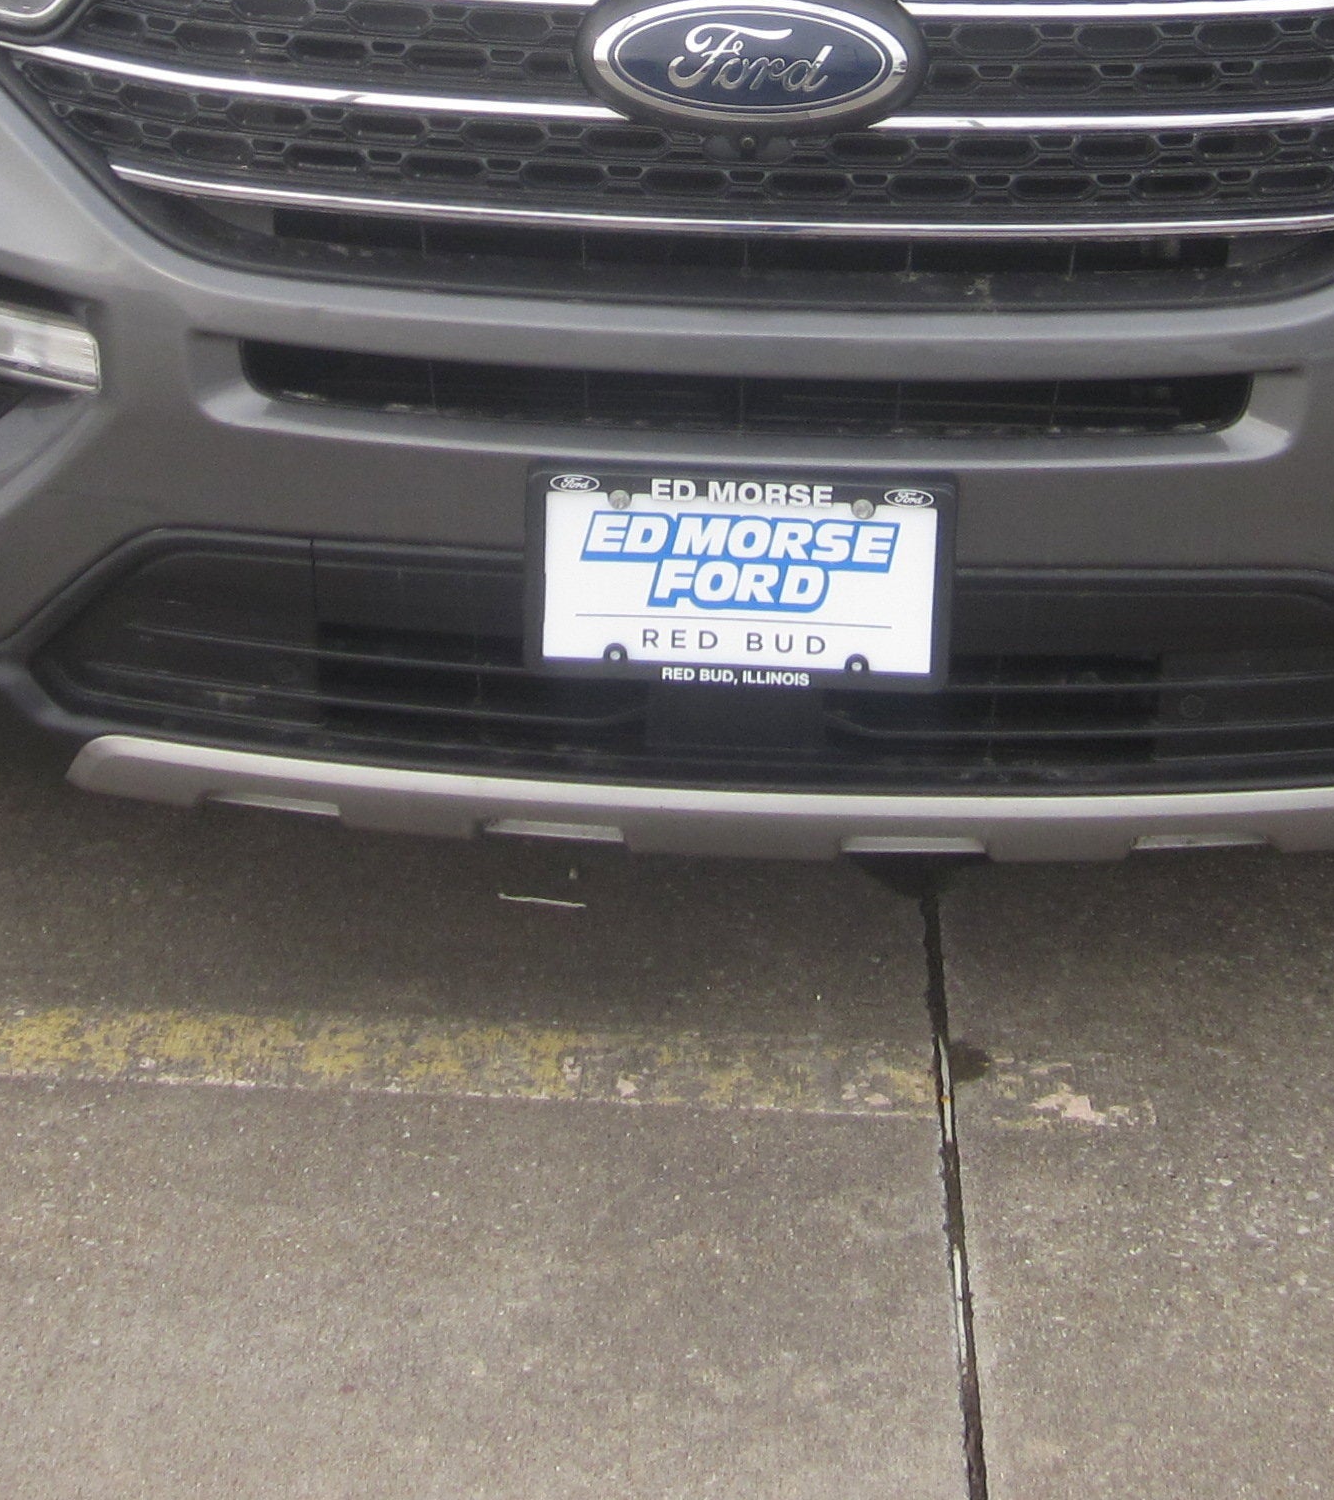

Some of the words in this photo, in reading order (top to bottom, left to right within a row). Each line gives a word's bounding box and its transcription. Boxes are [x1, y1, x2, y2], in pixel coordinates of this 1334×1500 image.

[668, 23, 833, 92] Ford
[651, 478, 696, 501] ED
[708, 481, 833, 508] MORSE
[586, 514, 668, 554] ED
[671, 516, 895, 564] MORSE
[653, 558, 825, 605] FORD
[642, 628, 718, 650] RED
[746, 632, 826, 655] BUD
[661, 666, 695, 681] RED
[699, 669, 738, 685] BUD,
[742, 670, 810, 687] ILLINOIS
